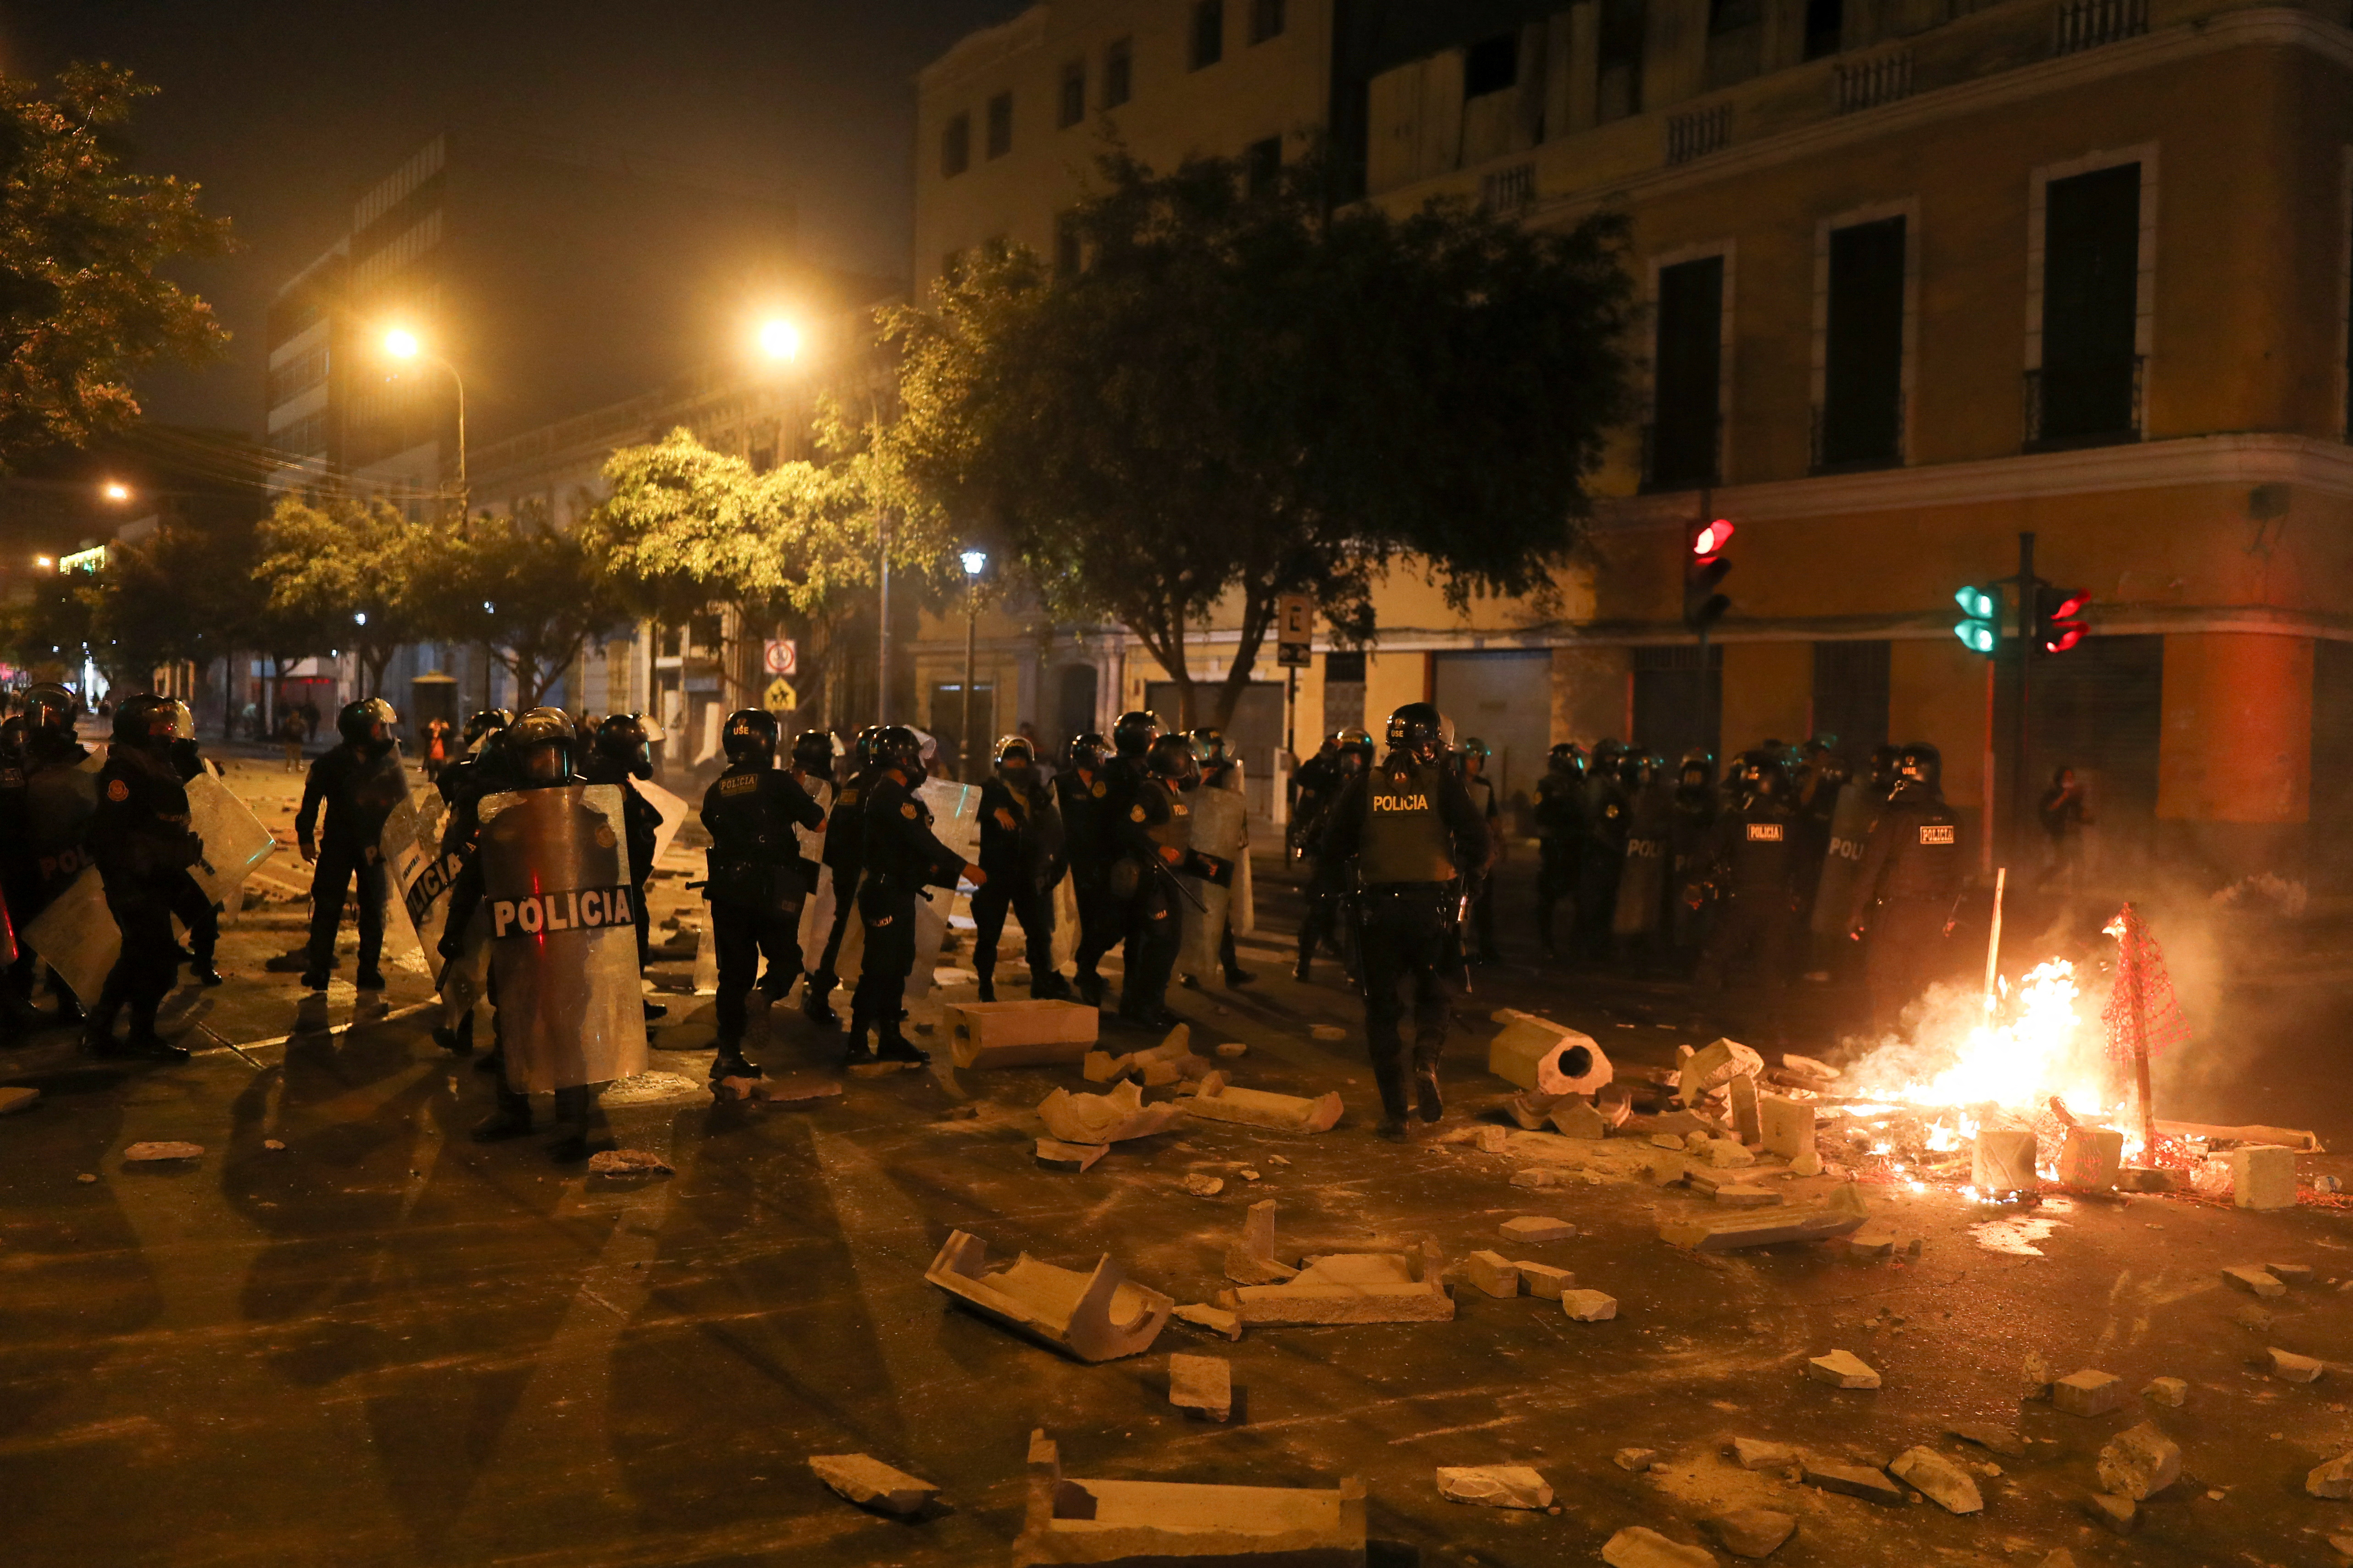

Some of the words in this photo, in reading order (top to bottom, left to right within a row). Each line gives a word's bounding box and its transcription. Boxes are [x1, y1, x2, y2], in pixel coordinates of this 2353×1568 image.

[733, 726, 749, 735] USE
[721, 776, 755, 790] POLICIA
[1373, 794, 1428, 811] POLICIA
[1750, 826, 1779, 838] POLICIA
[1922, 828, 1953, 841] POLICIA
[410, 852, 464, 914] LICIA
[494, 889, 632, 937] POLICIA
